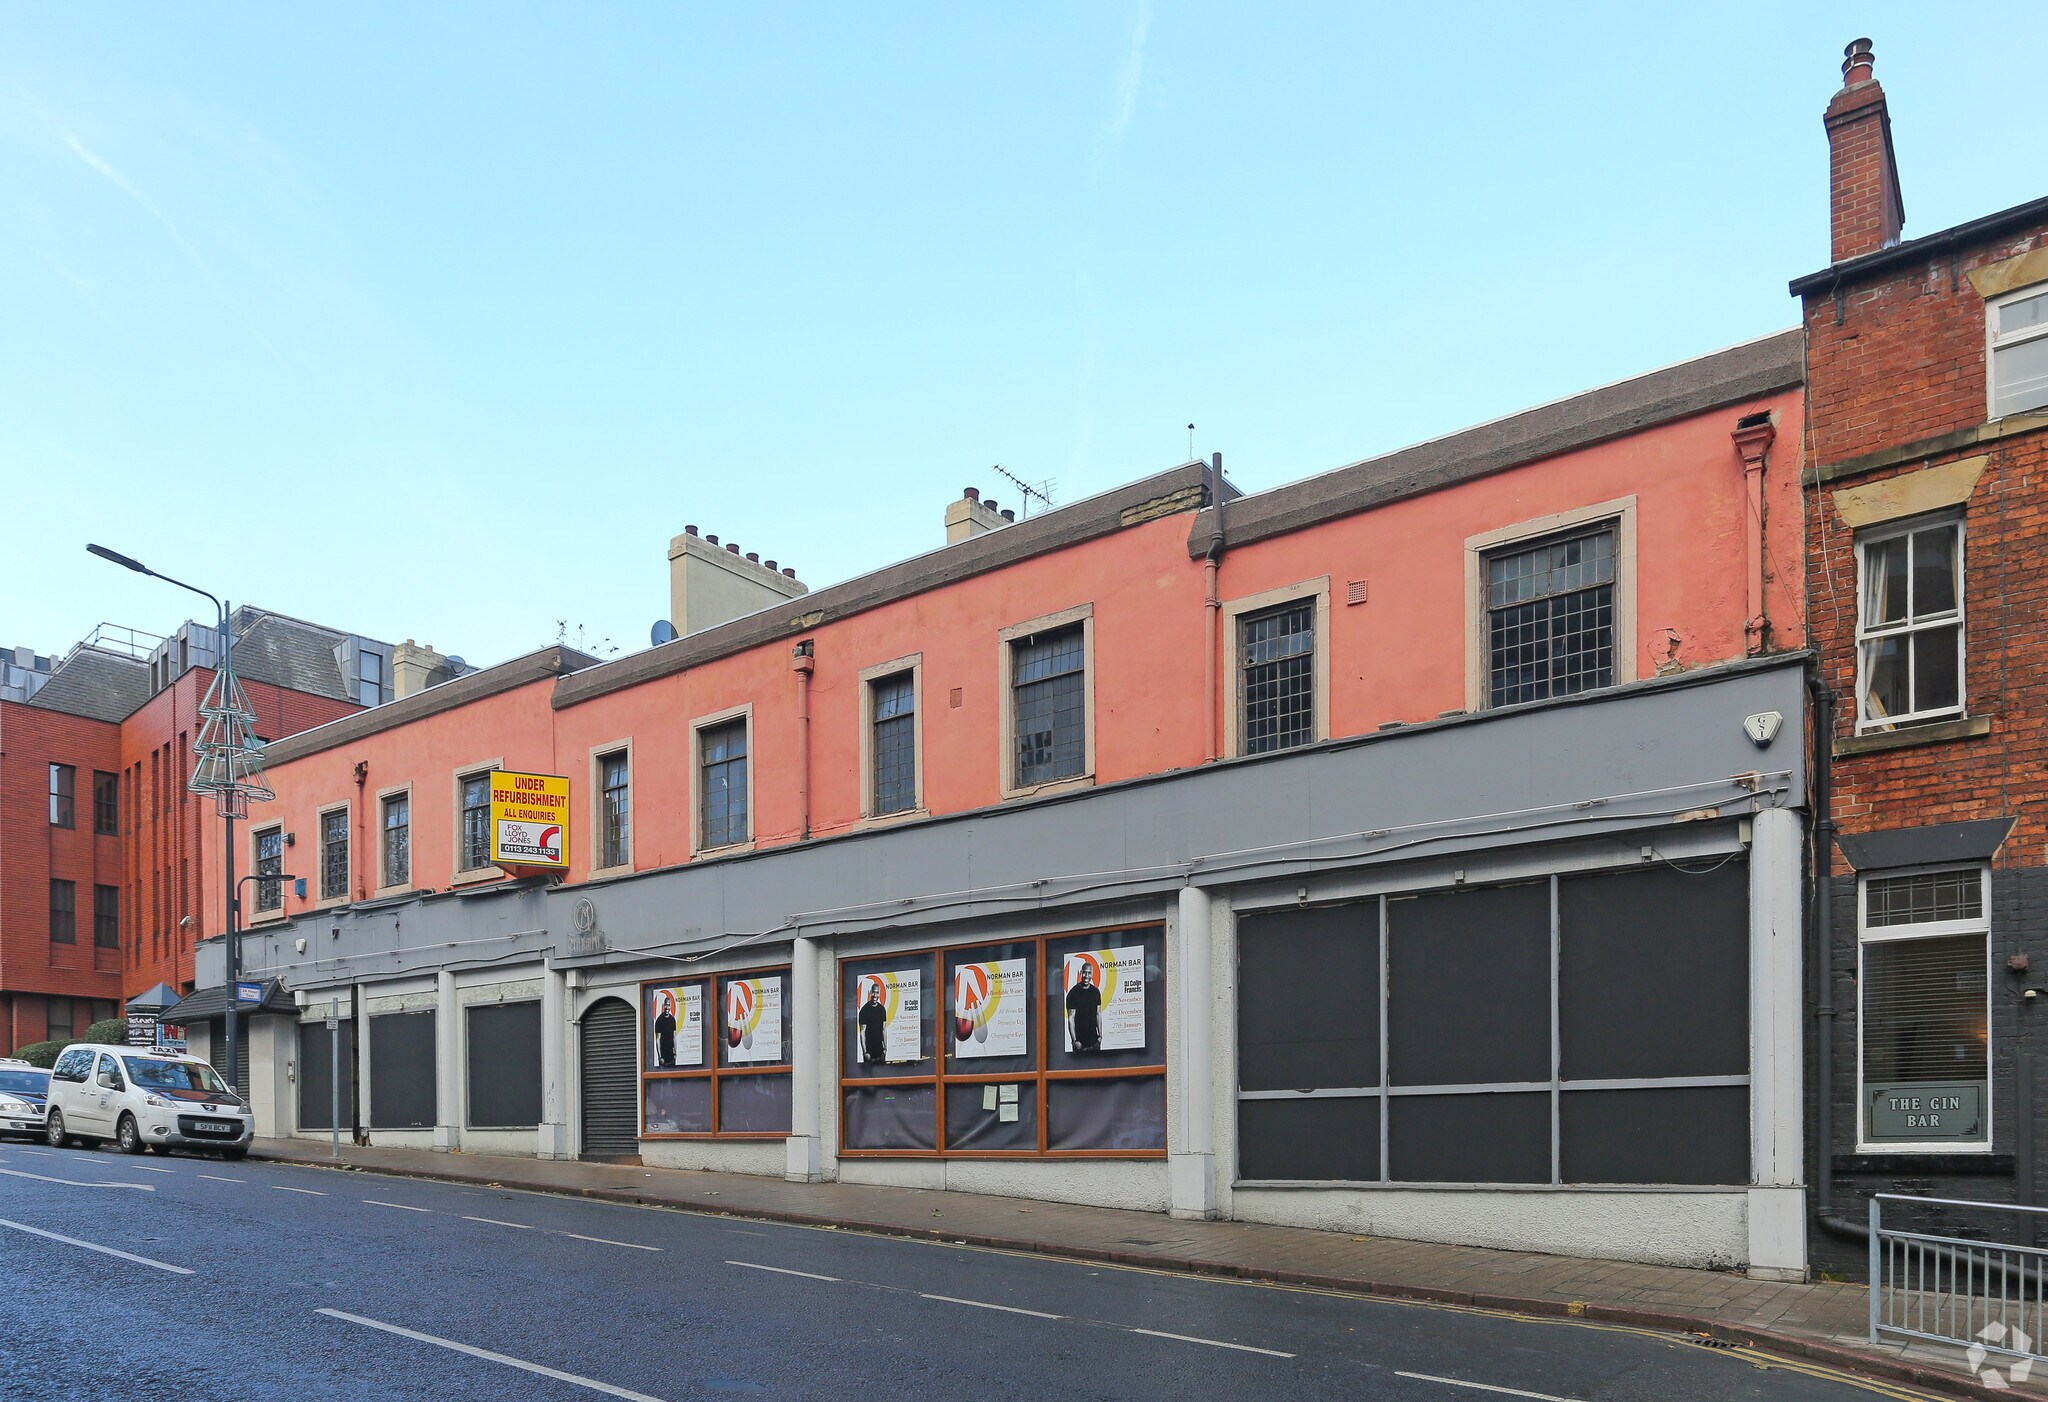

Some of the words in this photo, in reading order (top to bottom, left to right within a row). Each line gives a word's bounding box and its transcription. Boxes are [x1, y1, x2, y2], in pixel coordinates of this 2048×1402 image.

[515, 777, 545, 791] UNDER
[493, 790, 566, 808] REFURBISHMENT
[504, 808, 517, 817] ALL
[519, 809, 556, 821] ENQUIRIES
[505, 830, 527, 838] LLOYD
[507, 836, 531, 844] JONES
[504, 845, 522, 853] 0113
[523, 846, 537, 854] 243
[1100, 960, 1127, 969] NORMAN
[1128, 959, 1141, 967] BAR
[986, 972, 1011, 980] NORMAN
[886, 982, 907, 990] NORMAN
[1889, 1097, 1921, 1110] THE
[1929, 1096, 1961, 1110] GIN
[1906, 1114, 1941, 1127] BAR
